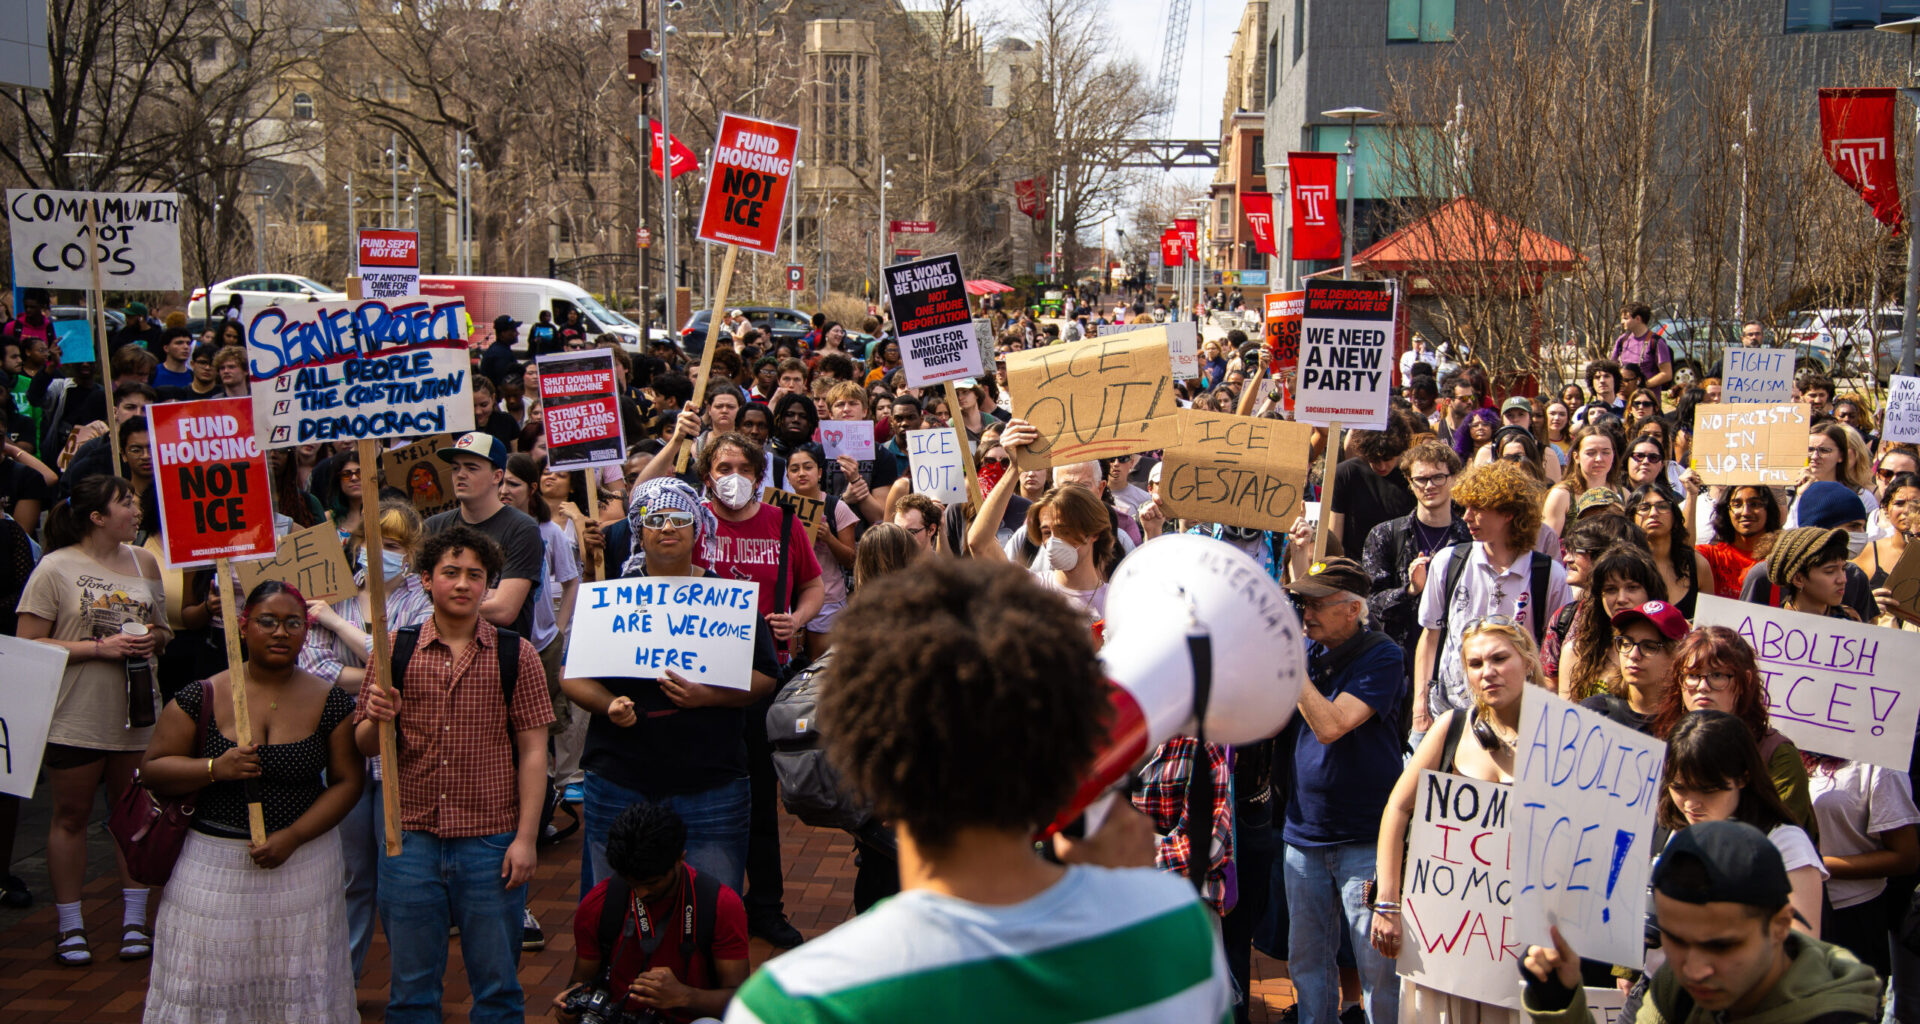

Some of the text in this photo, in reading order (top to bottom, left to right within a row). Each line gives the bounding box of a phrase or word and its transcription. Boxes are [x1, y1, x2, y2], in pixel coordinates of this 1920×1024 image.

[736, 131, 779, 155] FUND
[717, 146, 790, 177] HOUSING
[722, 167, 777, 201] NOT
[12, 193, 178, 223] COMMUNITY
[724, 196, 763, 228] ICE
[77, 224, 134, 244] NOT
[361, 238, 416, 249] FUND SEPTA
[33, 242, 135, 275] COPS
[370, 248, 408, 258] NOT ICE!
[362, 273, 417, 282] NOT ANOTHER
[893, 262, 950, 284] WE WON'T
[894, 273, 957, 296] BE DIVIDED
[371, 281, 409, 290] DIME FOR
[928, 290, 948, 302] NOT
[1308, 288, 1391, 301] THE DEMOCRATS
[915, 298, 964, 317] ONE MORE
[1310, 300, 1389, 312] WON'T SAVE US
[902, 310, 968, 331] DEPORTATION
[1267, 322, 1285, 336] ICE
[911, 330, 964, 349] UNITE FOR
[1306, 327, 1385, 346] WE NEED
[910, 340, 969, 360] IMMIGRANT
[923, 352, 961, 368] RIGHTS
[1305, 346, 1383, 369] A NEW
[294, 351, 434, 392] ALL PEOPLE
[1030, 338, 1130, 390] ICE
[1730, 351, 1786, 373] FIGHT
[294, 369, 465, 412] THE CONSTITUTION
[543, 372, 611, 386] SHUT DOWN THE
[544, 381, 604, 395] WAR MACHINE
[1303, 368, 1382, 392] PARTY
[1726, 376, 1788, 392] FASCISM.
[1900, 380, 1915, 390] NO
[547, 402, 606, 422] STRIKE TO
[1024, 376, 1169, 454] OUT!
[1305, 406, 1333, 414] SOCIALIST
[1889, 401, 1900, 410] IS
[1889, 411, 1901, 421] ON
[178, 415, 239, 441] FUND
[297, 405, 445, 442] DEMOCRACY
[549, 411, 616, 434] STOP ARMS
[1701, 414, 1722, 430] NO
[552, 424, 608, 445] EXPORTS!
[912, 431, 953, 455] ICE
[1195, 420, 1269, 450] ICE
[1724, 430, 1755, 448] IN
[178, 460, 250, 501] NOT
[917, 465, 957, 492] OUT.
[1168, 463, 1297, 518] GESTAPO
[194, 497, 246, 534] ICE
[701, 534, 732, 563] SNT
[77, 575, 113, 591] Ford
[592, 583, 754, 610] IMMIGRANTS
[612, 612, 752, 641] ARE WELCOME
[1738, 616, 1880, 674] ABOLISH
[635, 646, 708, 673] HERE.
[1758, 669, 1901, 737] ICE!
[1522, 702, 1662, 816] ABOLISH
[1431, 824, 1512, 870] IC
[1520, 799, 1637, 924] ICE!
[1411, 858, 1456, 896] NO
[685, 904, 693, 934] Canon
